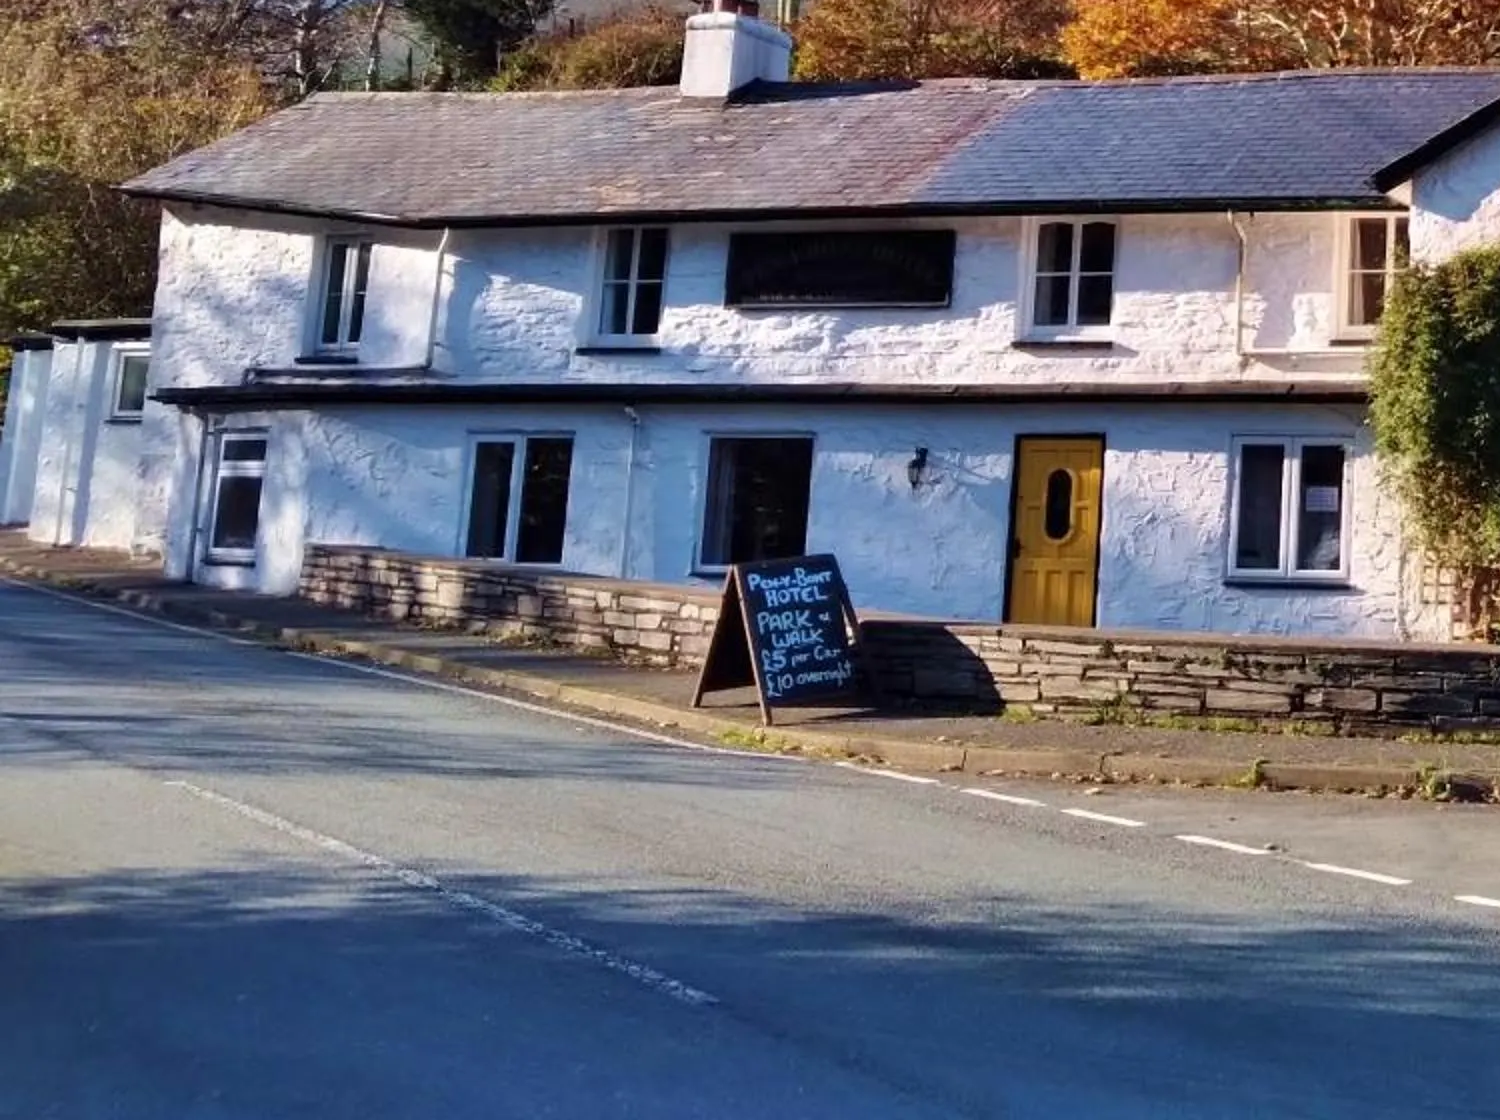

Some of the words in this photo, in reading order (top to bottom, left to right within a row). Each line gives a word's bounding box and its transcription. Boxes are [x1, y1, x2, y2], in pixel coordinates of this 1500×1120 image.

[765, 586, 828, 607] HOTEL
[757, 610, 813, 634] PARK
[771, 629, 824, 648] WALK
[761, 649, 787, 672] £5
[791, 653, 811, 668] per
[765, 674, 794, 697] £10
